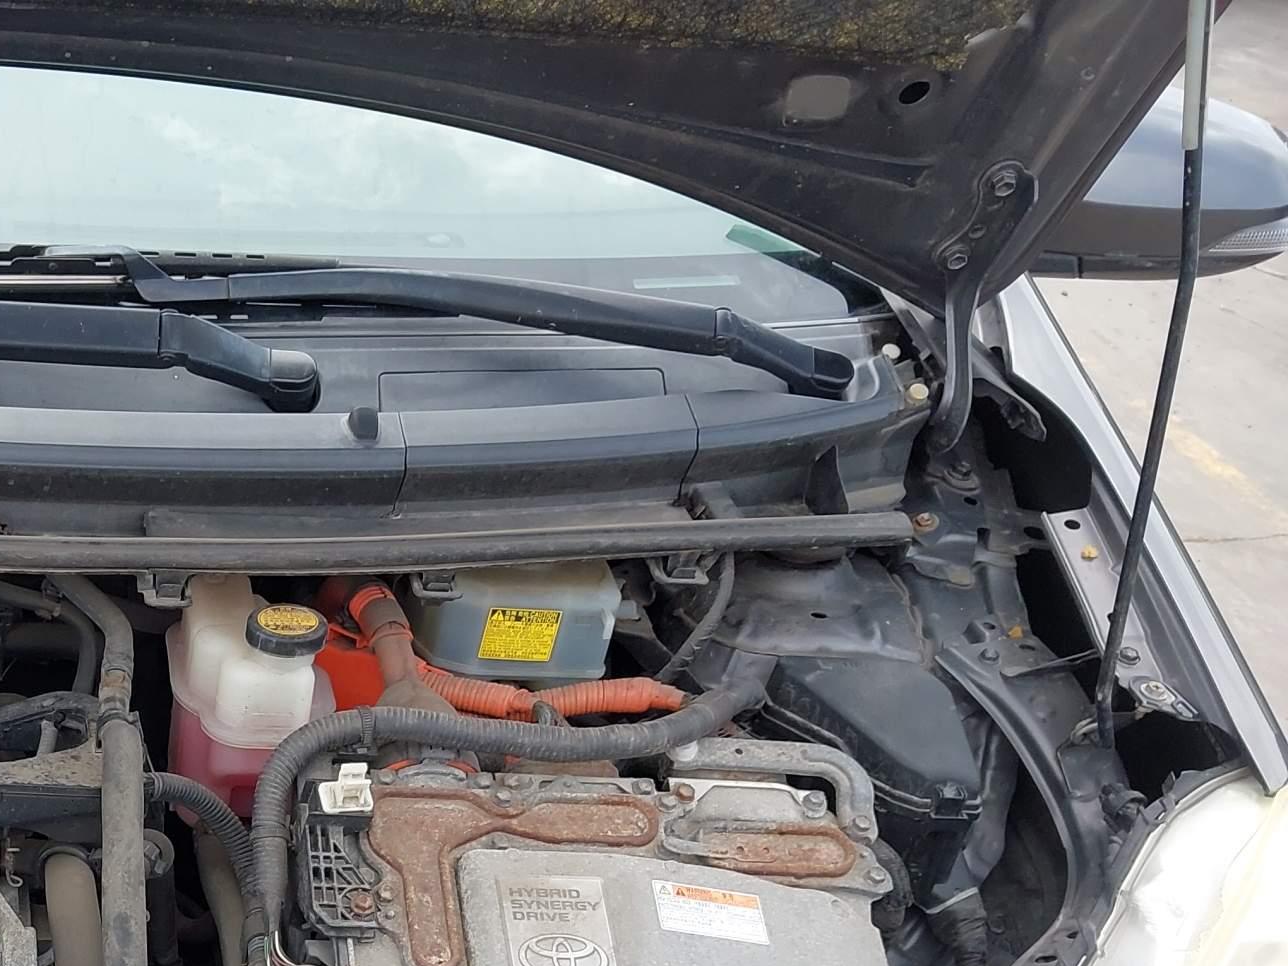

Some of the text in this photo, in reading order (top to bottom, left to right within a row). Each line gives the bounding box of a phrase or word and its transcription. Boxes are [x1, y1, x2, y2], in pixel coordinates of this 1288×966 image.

[508, 887, 581, 899] HYBRID
[511, 899, 601, 911] SYNERGY
[512, 911, 571, 922] DRIVE
